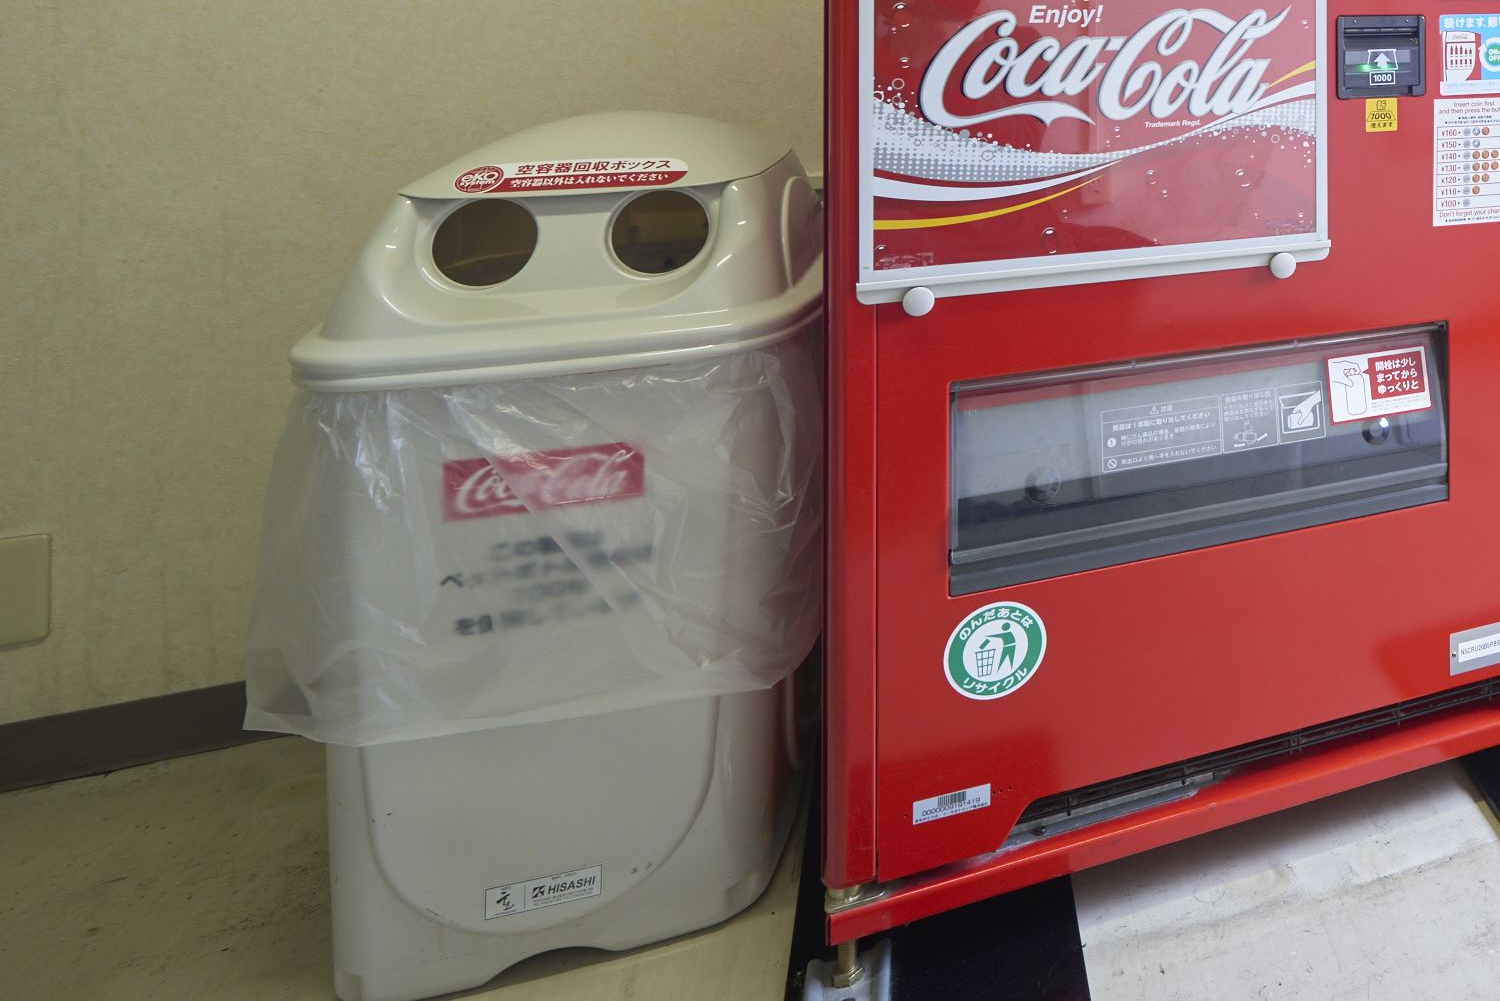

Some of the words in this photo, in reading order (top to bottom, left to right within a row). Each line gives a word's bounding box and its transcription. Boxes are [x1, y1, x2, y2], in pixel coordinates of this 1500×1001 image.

[1028, 4, 1104, 28] Enjoy!
[919, 4, 1292, 130] Coca-Cola
[1372, 74, 1392, 82] 1000
[1371, 112, 1392, 121] 1000
[1144, 120, 1181, 129] Trademark
[1441, 128, 1457, 137] ¥160
[1441, 140, 1457, 149] ¥150
[1441, 152, 1457, 160] ¥140
[515, 159, 672, 176] 空容器回収ボックス
[1441, 164, 1457, 172] ¥130
[459, 178, 496, 187] system
[510, 173, 669, 188] 空容器以外は入れないでください
[1441, 176, 1457, 184] ¥120
[1441, 187, 1457, 196] ¥110
[1441, 199, 1457, 208] ¥100
[1439, 210, 1455, 218] Don't
[1455, 209, 1473, 217] forget
[1374, 356, 1417, 372] 開栓は少し
[1376, 368, 1418, 383] まってから
[1377, 380, 1419, 395] ゆっくりと
[959, 607, 1034, 642] のんだあとは
[962, 666, 1029, 694] リサイクル
[547, 875, 596, 895] HISASHI
